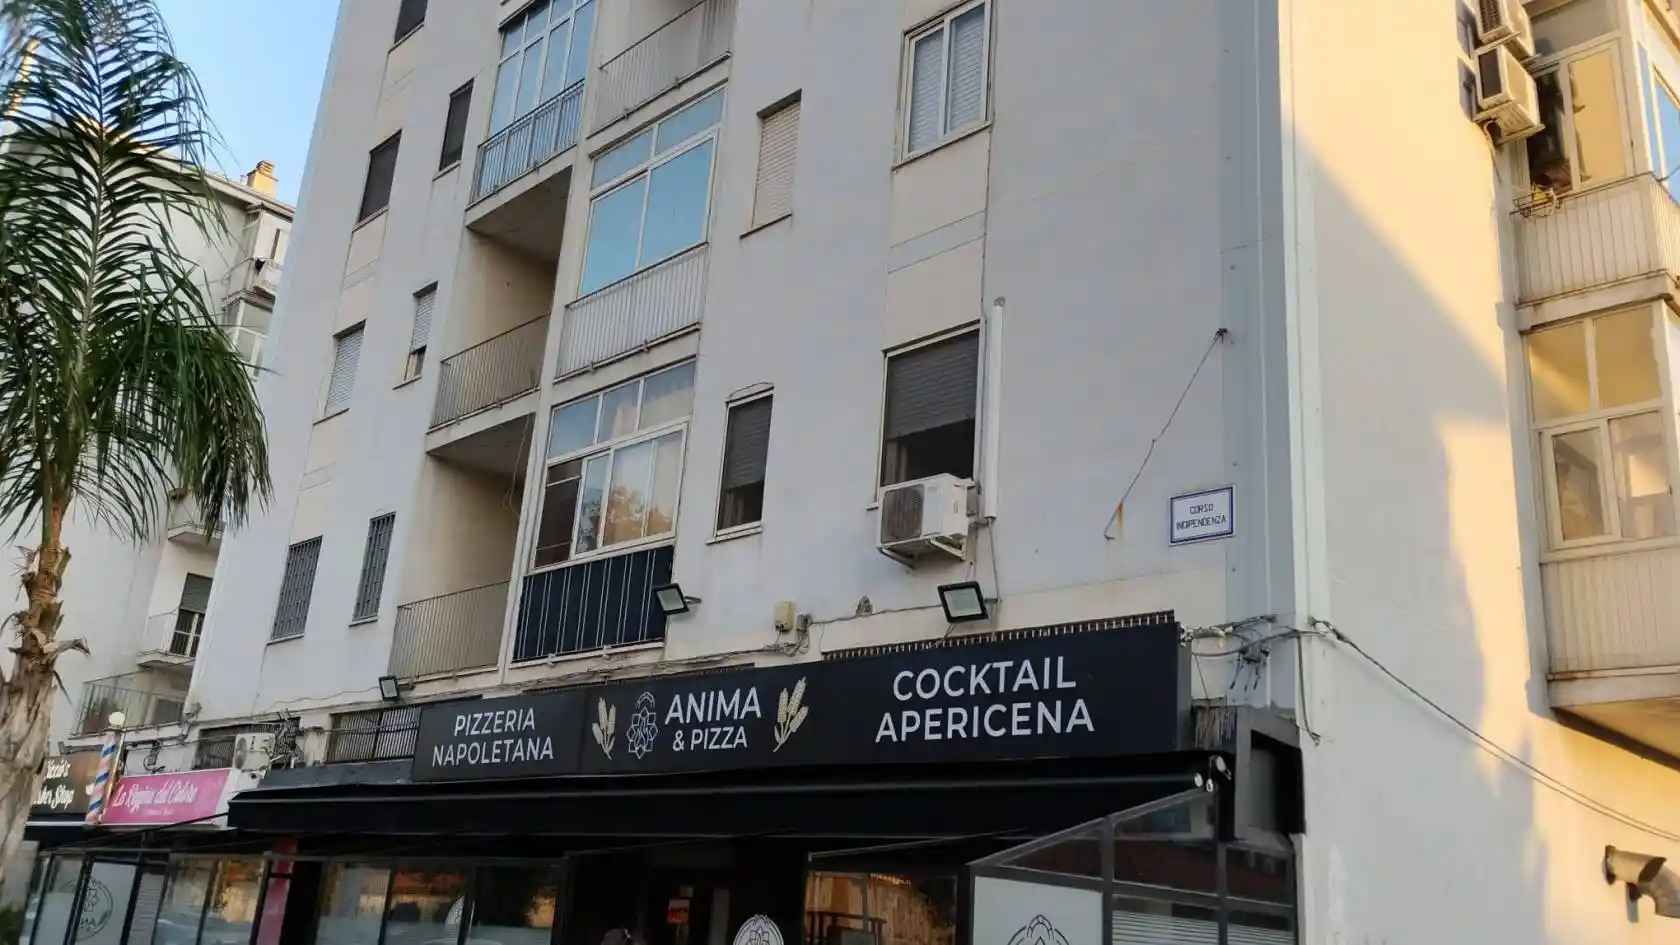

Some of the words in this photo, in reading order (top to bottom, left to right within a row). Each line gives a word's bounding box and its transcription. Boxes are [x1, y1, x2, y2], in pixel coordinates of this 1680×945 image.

[1176, 514, 1227, 530] INDIPENDENZA
[1189, 503, 1214, 514] CORSO
[893, 655, 1077, 701] COCKTAIL
[664, 686, 762, 725] ANIMA
[875, 698, 1096, 743] APERICENA
[453, 707, 535, 736] PIZZERIA
[432, 736, 554, 768] NAPOLETANA
[672, 730, 685, 752] &
[690, 725, 748, 751] PIZZA
